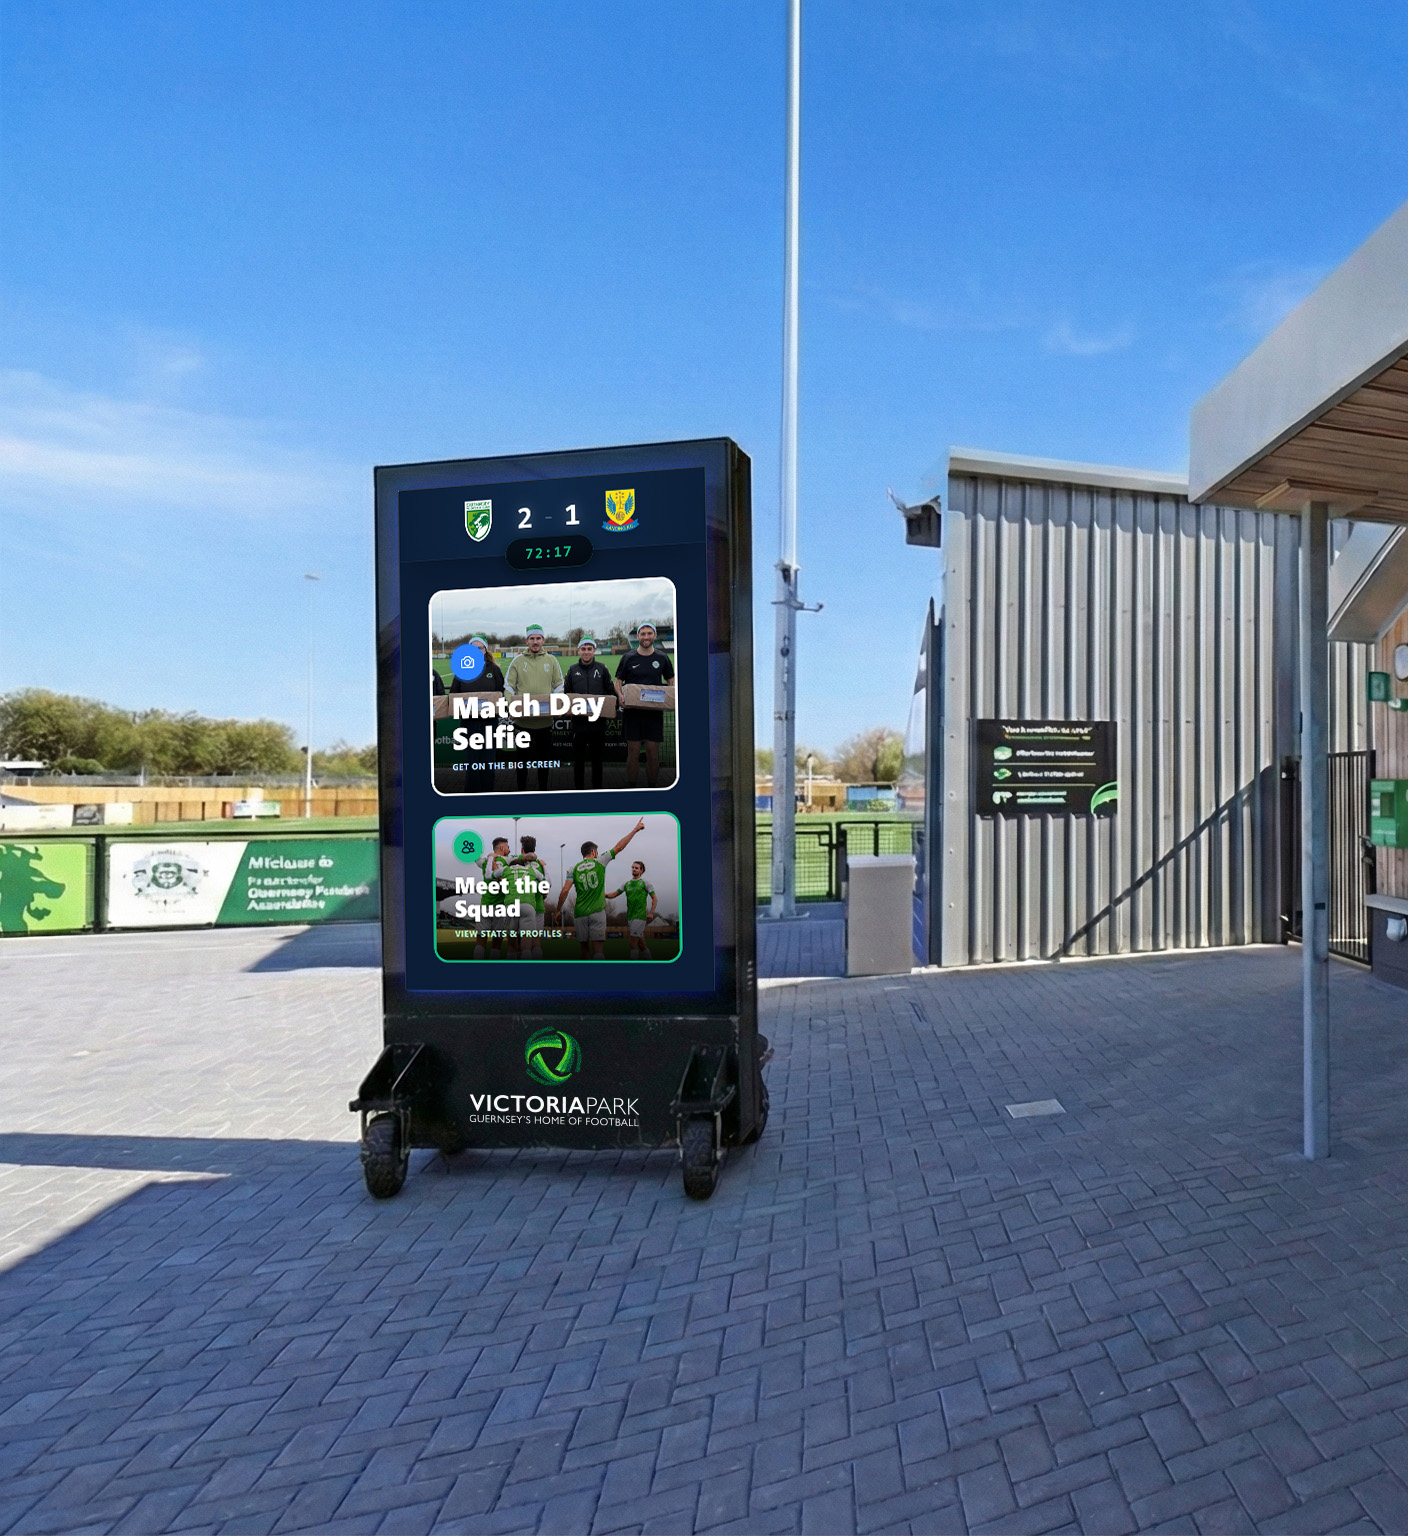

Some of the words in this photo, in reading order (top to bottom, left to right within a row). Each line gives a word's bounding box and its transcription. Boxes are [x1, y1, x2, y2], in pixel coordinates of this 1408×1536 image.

[518, 507, 532, 529] 2
[565, 504, 580, 526] 1
[525, 545, 572, 560] 72:17
[453, 693, 540, 719] Match
[550, 693, 605, 721] Day
[453, 725, 531, 751] Selfie
[452, 762, 470, 771] GET
[471, 762, 486, 771] ON
[488, 761, 506, 770] THE
[508, 761, 524, 770] BIG
[526, 760, 561, 769] SCREEN
[455, 877, 509, 894] Meet
[515, 875, 550, 894] the
[455, 899, 521, 922] Squad
[454, 930, 478, 938] VIEW
[480, 930, 507, 938] STATS
[509, 930, 518, 938] &
[520, 929, 562, 938] PROFILES
[469, 1114, 531, 1125] GUERNSEY'S
[534, 1116, 566, 1125] HOME
[568, 1117, 583, 1126] OF
[585, 1117, 640, 1127] FOOTBALL
